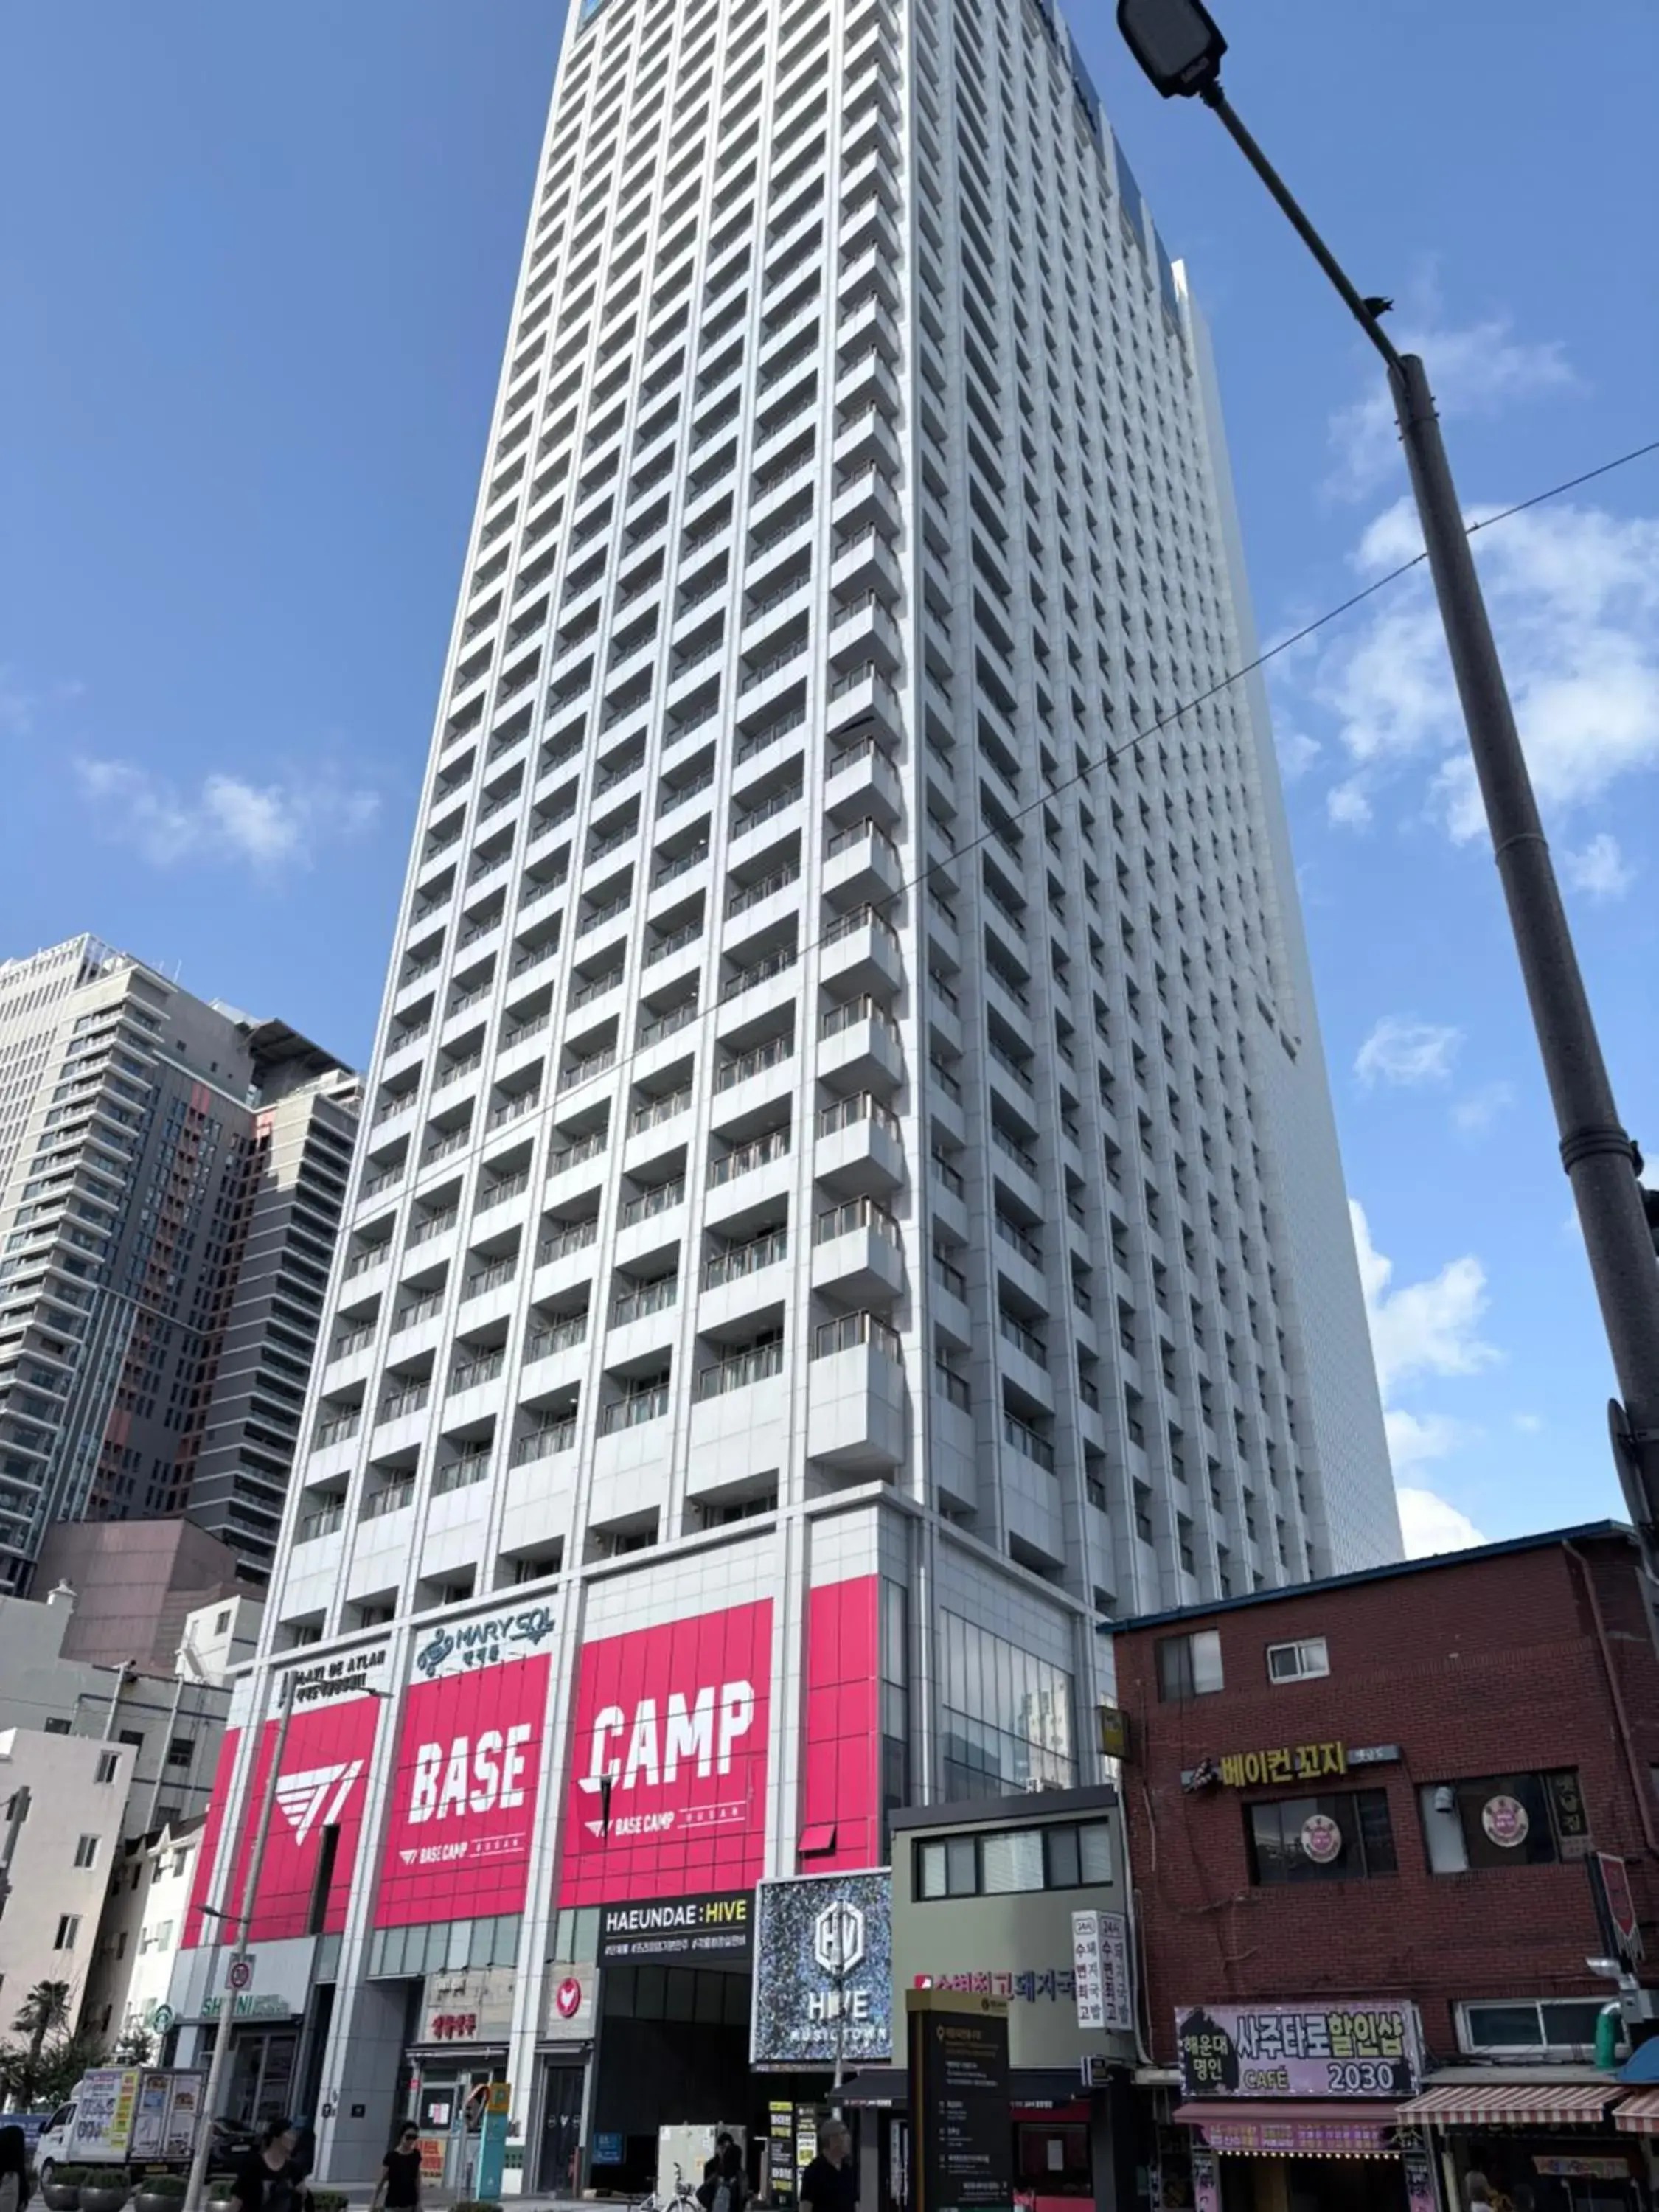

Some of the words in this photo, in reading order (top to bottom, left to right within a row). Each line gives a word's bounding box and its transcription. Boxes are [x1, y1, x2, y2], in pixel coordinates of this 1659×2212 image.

[408, 1723, 531, 1824] BASE
[578, 1680, 754, 1794] CAMP
[1220, 1747, 1293, 1787] 베이컨
[1295, 1741, 1347, 1780] 꼬지
[616, 1816, 641, 1836] BASE
[644, 1811, 675, 1832] CAMP
[420, 1845, 442, 1864] BASE
[442, 1842, 468, 1861] CAMP
[1185, 2035, 1229, 2056] 해운대
[1193, 2058, 1222, 2081] 명인
[1327, 2063, 1394, 2091] 2030
